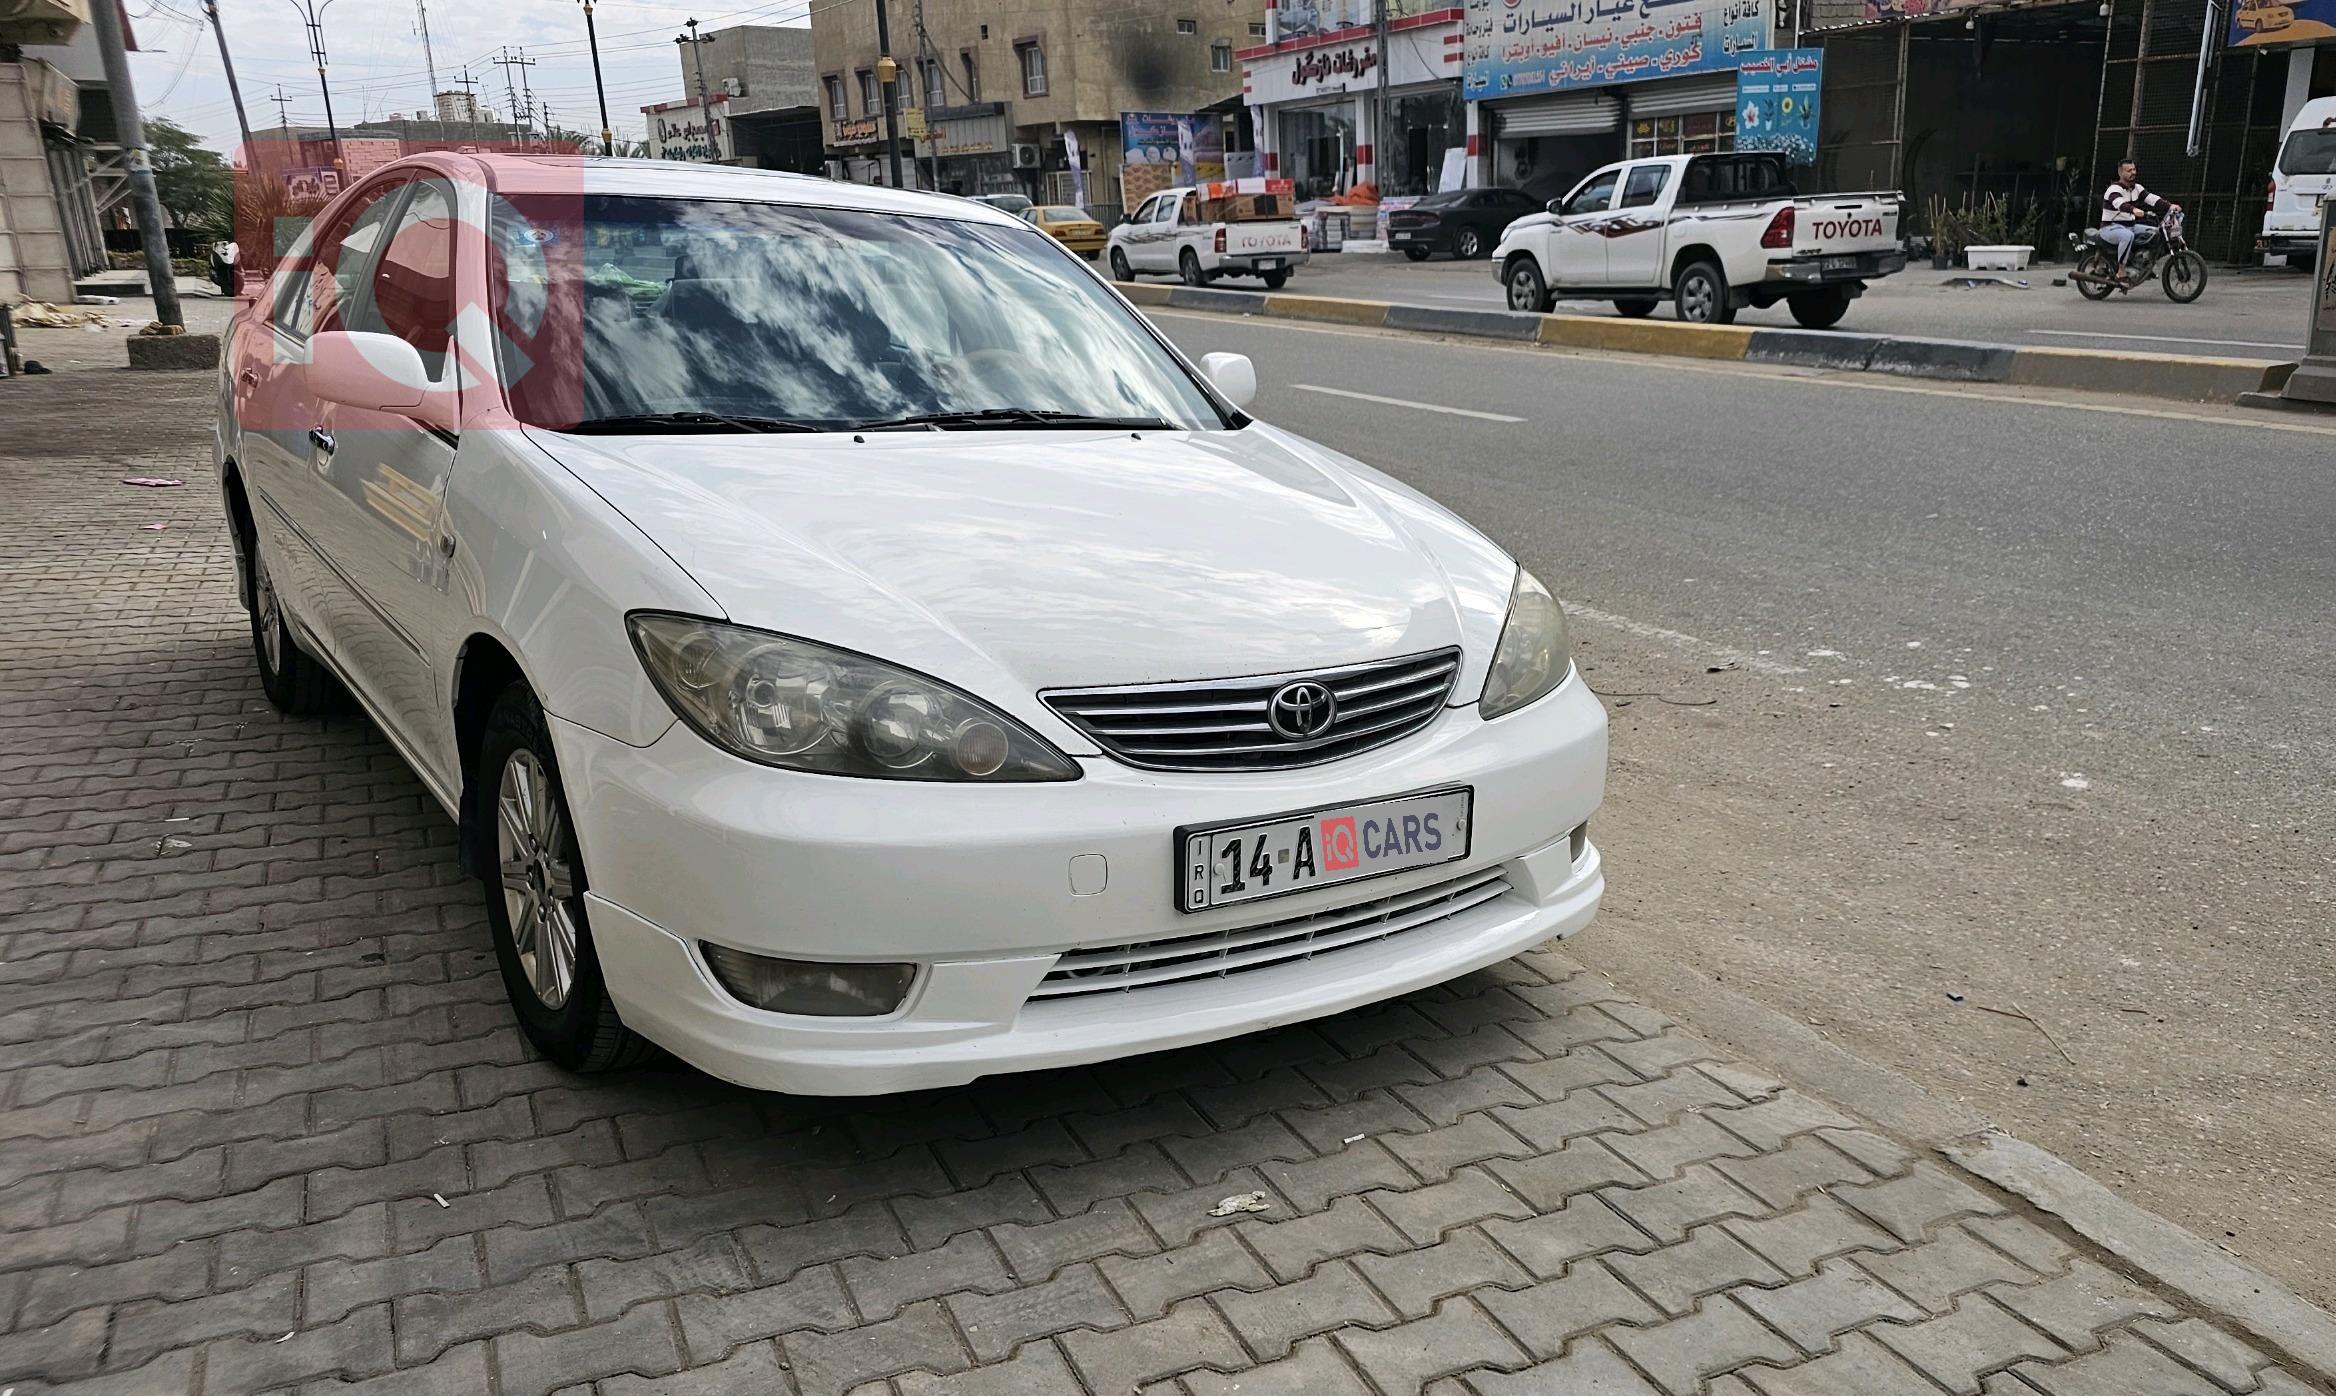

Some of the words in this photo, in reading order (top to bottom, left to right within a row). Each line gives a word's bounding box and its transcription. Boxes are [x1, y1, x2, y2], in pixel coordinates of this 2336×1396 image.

[1503, 1, 1582, 35] السيارات
[1572, 26, 1613, 52] نيسان
[1333, 46, 1377, 79] مفروشات
[1605, 52, 1649, 79] صيني
[1659, 40, 1703, 70] كوري
[1241, 233, 1292, 249] TOYOTA
[1812, 218, 1883, 241] TOYOTA
[1220, 833, 1273, 895] 14
[1292, 825, 1317, 880] A
